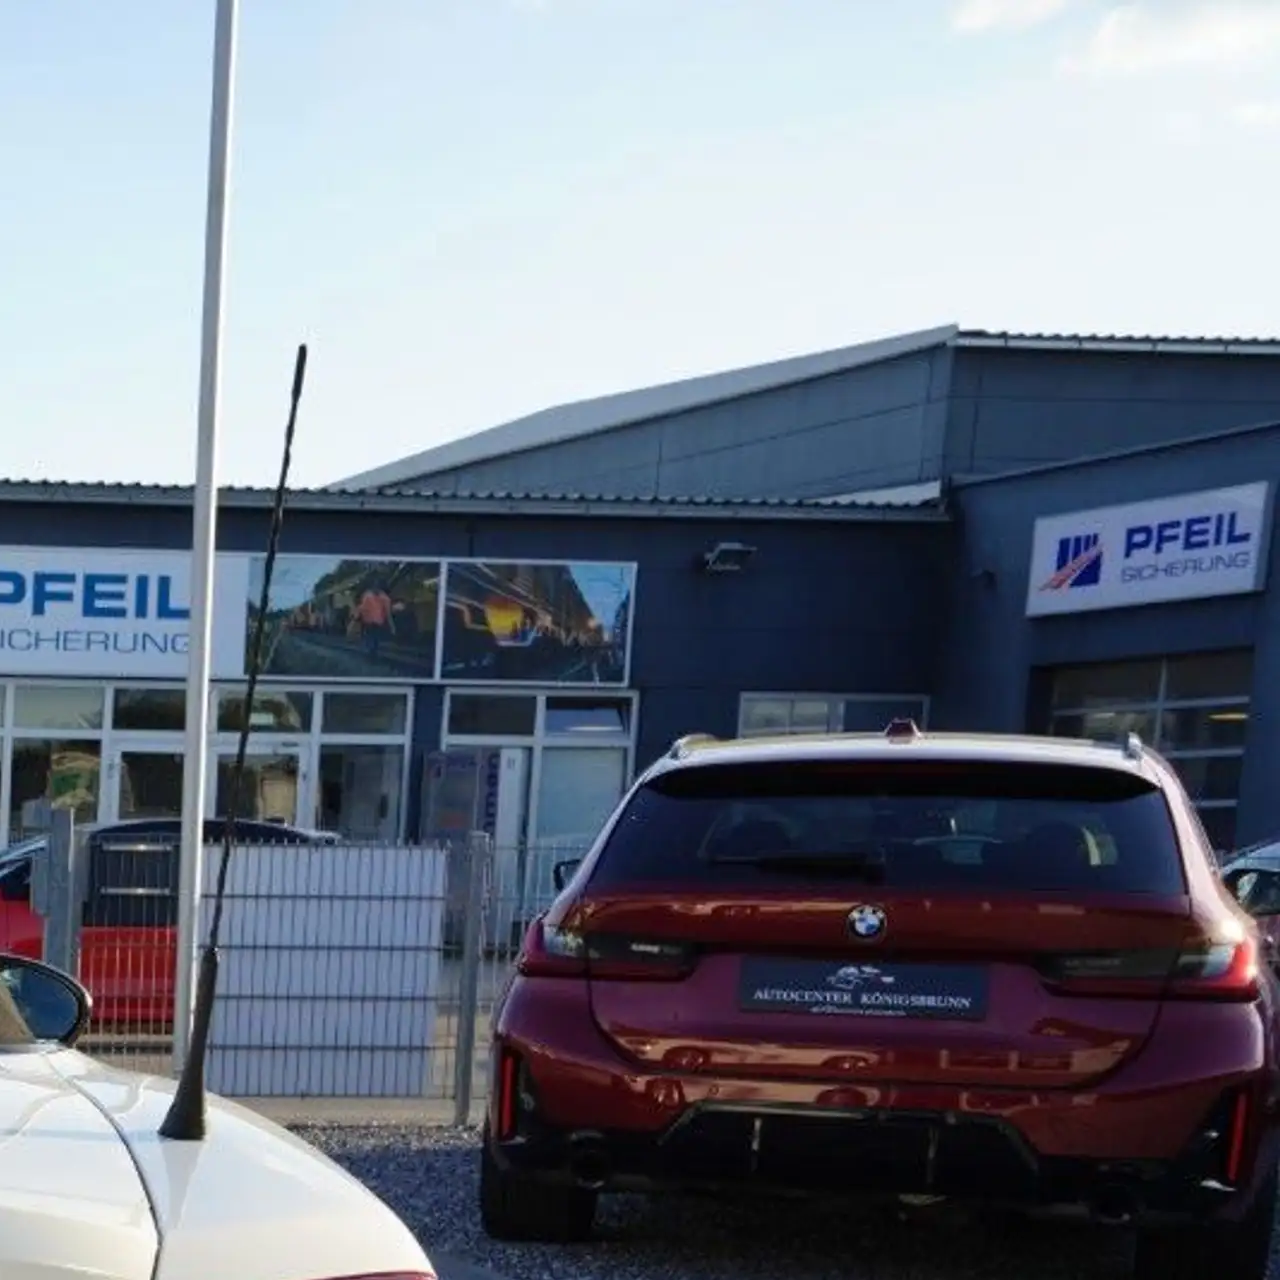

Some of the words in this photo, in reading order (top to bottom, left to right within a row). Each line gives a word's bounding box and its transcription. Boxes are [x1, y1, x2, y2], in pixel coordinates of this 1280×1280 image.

[1124, 512, 1251, 558] PFEIL
[1121, 552, 1251, 583] SICHERUNG
[753, 988, 852, 1004] AUTOCENTER
